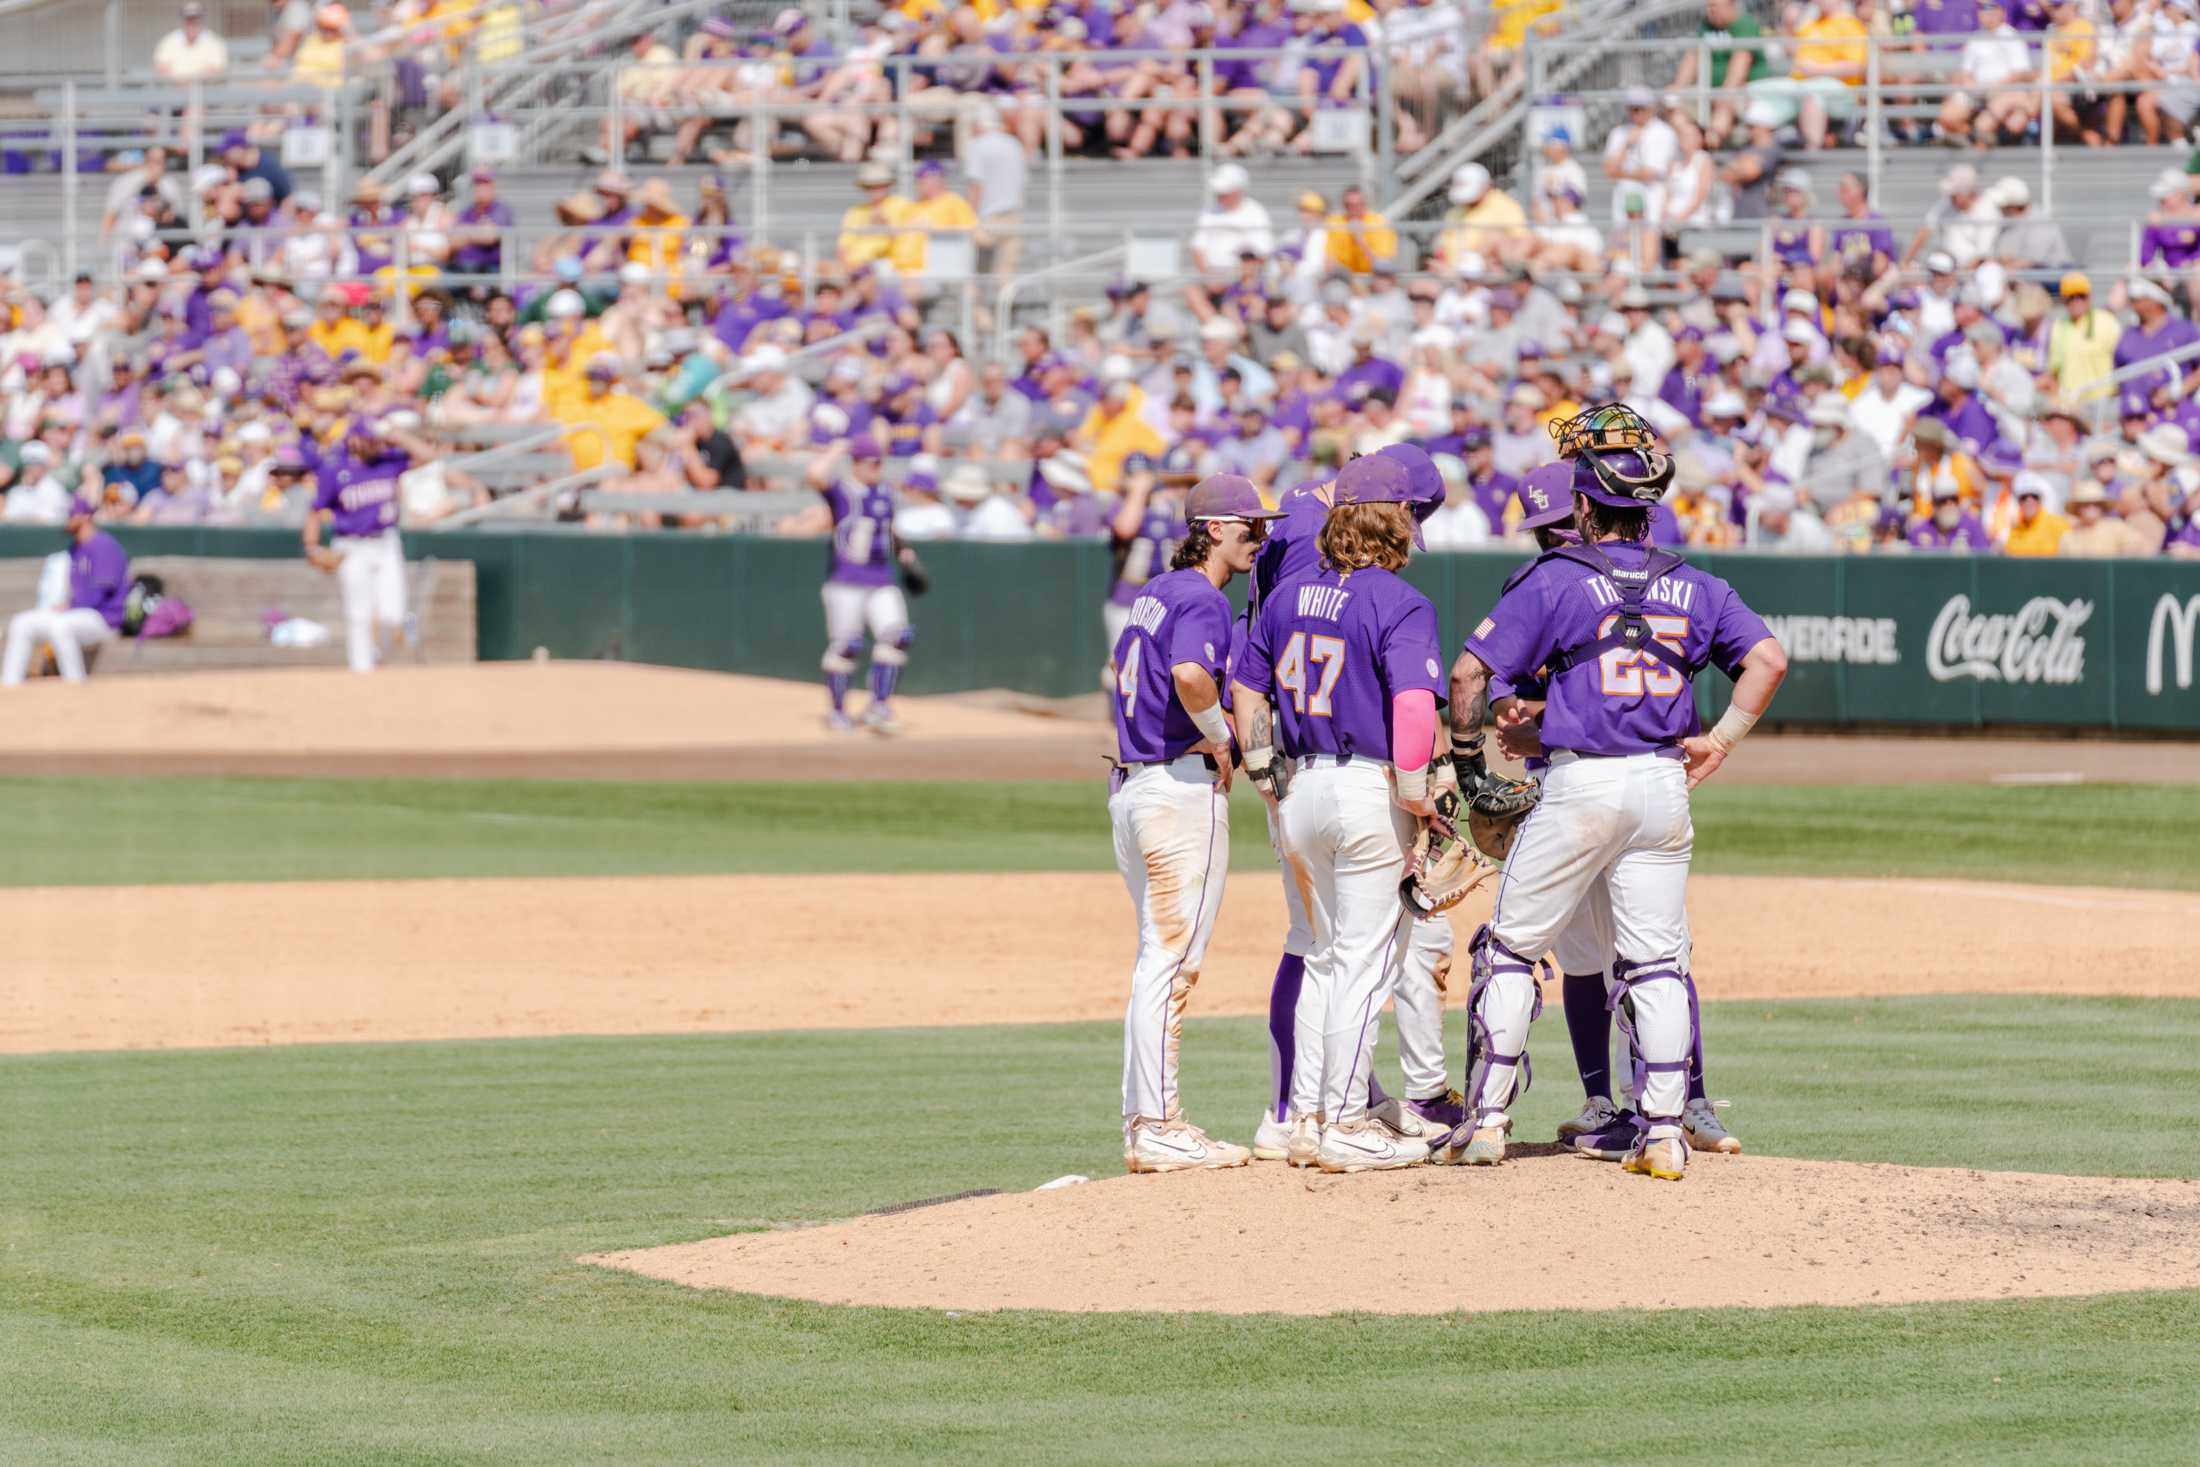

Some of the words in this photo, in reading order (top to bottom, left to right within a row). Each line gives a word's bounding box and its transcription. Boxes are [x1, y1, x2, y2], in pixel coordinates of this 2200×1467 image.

[1528, 485, 1549, 510] LSU
[1612, 569, 1649, 580] marucci
[1298, 585, 1349, 622] WHITE
[1598, 615, 1689, 696] 25
[1764, 615, 1898, 663] WERADE
[1120, 636, 1141, 717] 4
[1275, 631, 1345, 717] 47
